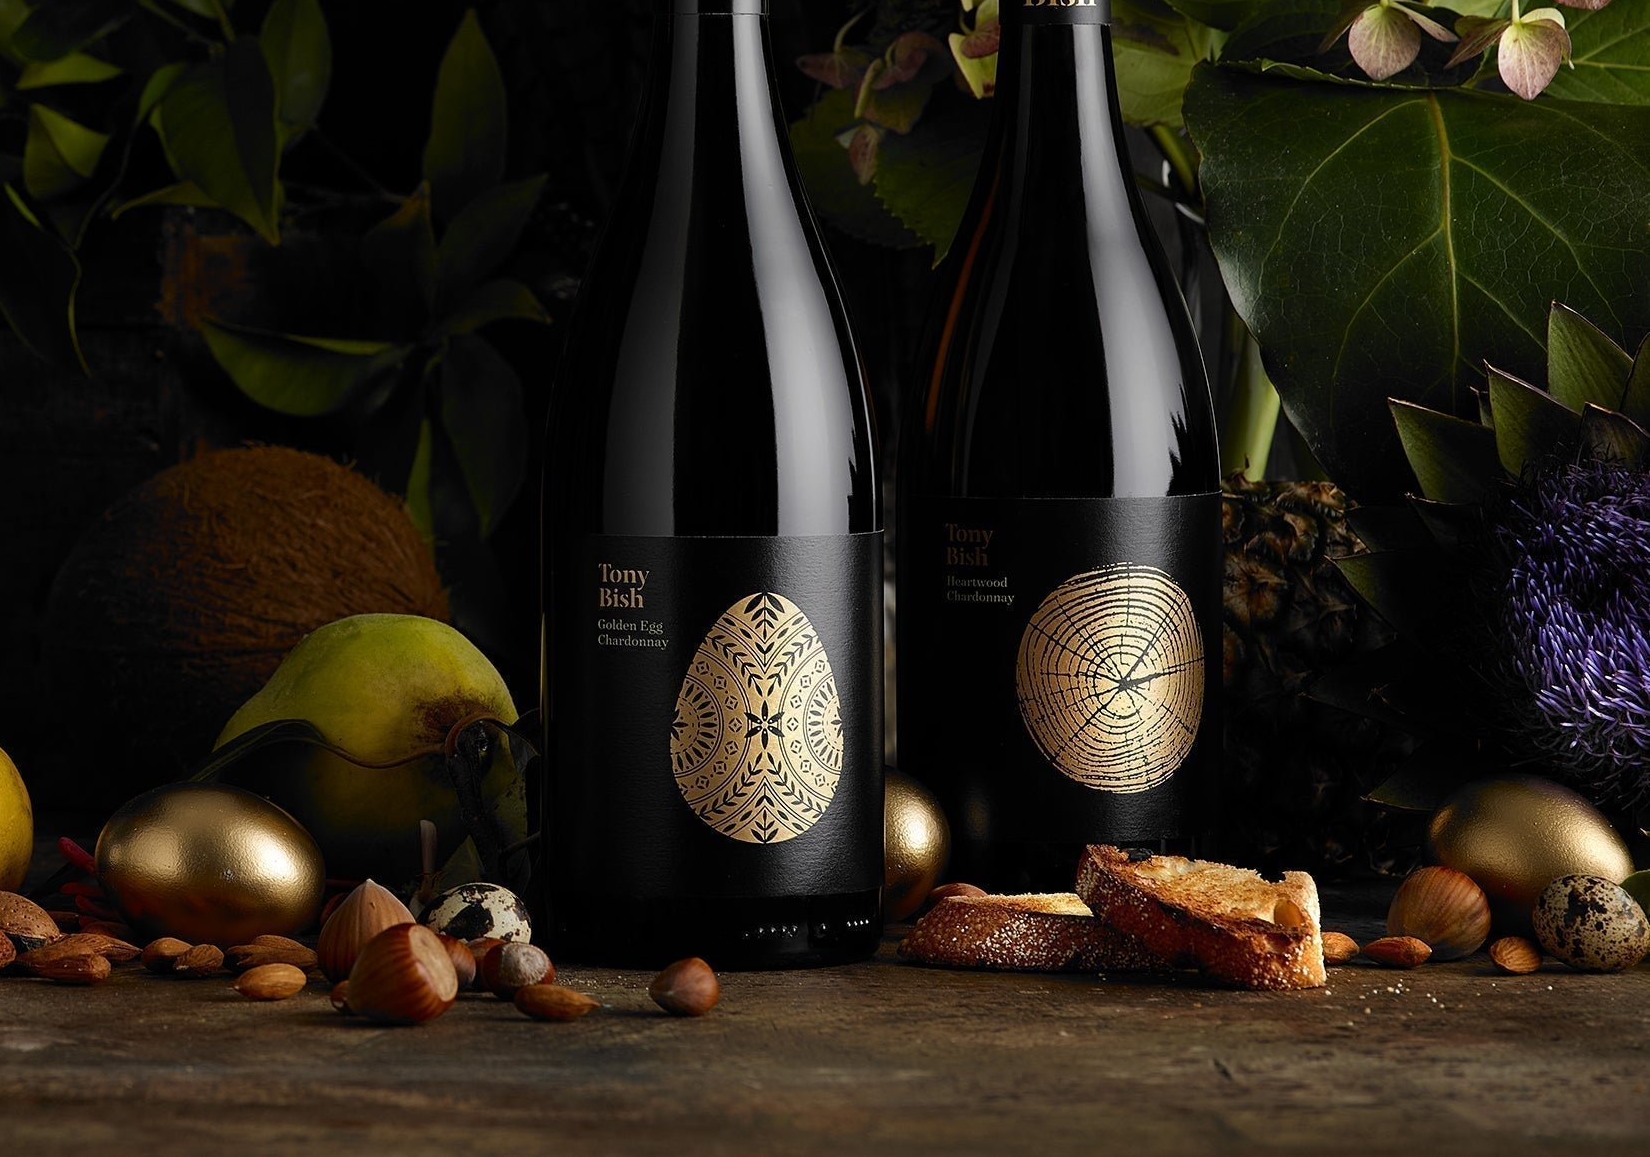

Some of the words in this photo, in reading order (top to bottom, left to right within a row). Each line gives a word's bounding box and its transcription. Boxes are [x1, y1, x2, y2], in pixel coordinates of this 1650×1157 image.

[944, 522, 994, 550] Tony
[945, 546, 990, 568] Bish
[598, 562, 650, 590] Tony
[946, 575, 1008, 588] Heartwood
[599, 587, 645, 609] Bish
[946, 590, 1015, 606] Chardonnay
[597, 618, 637, 631] Golden
[640, 620, 664, 635] Egg
[597, 633, 669, 650] Chardonnay
